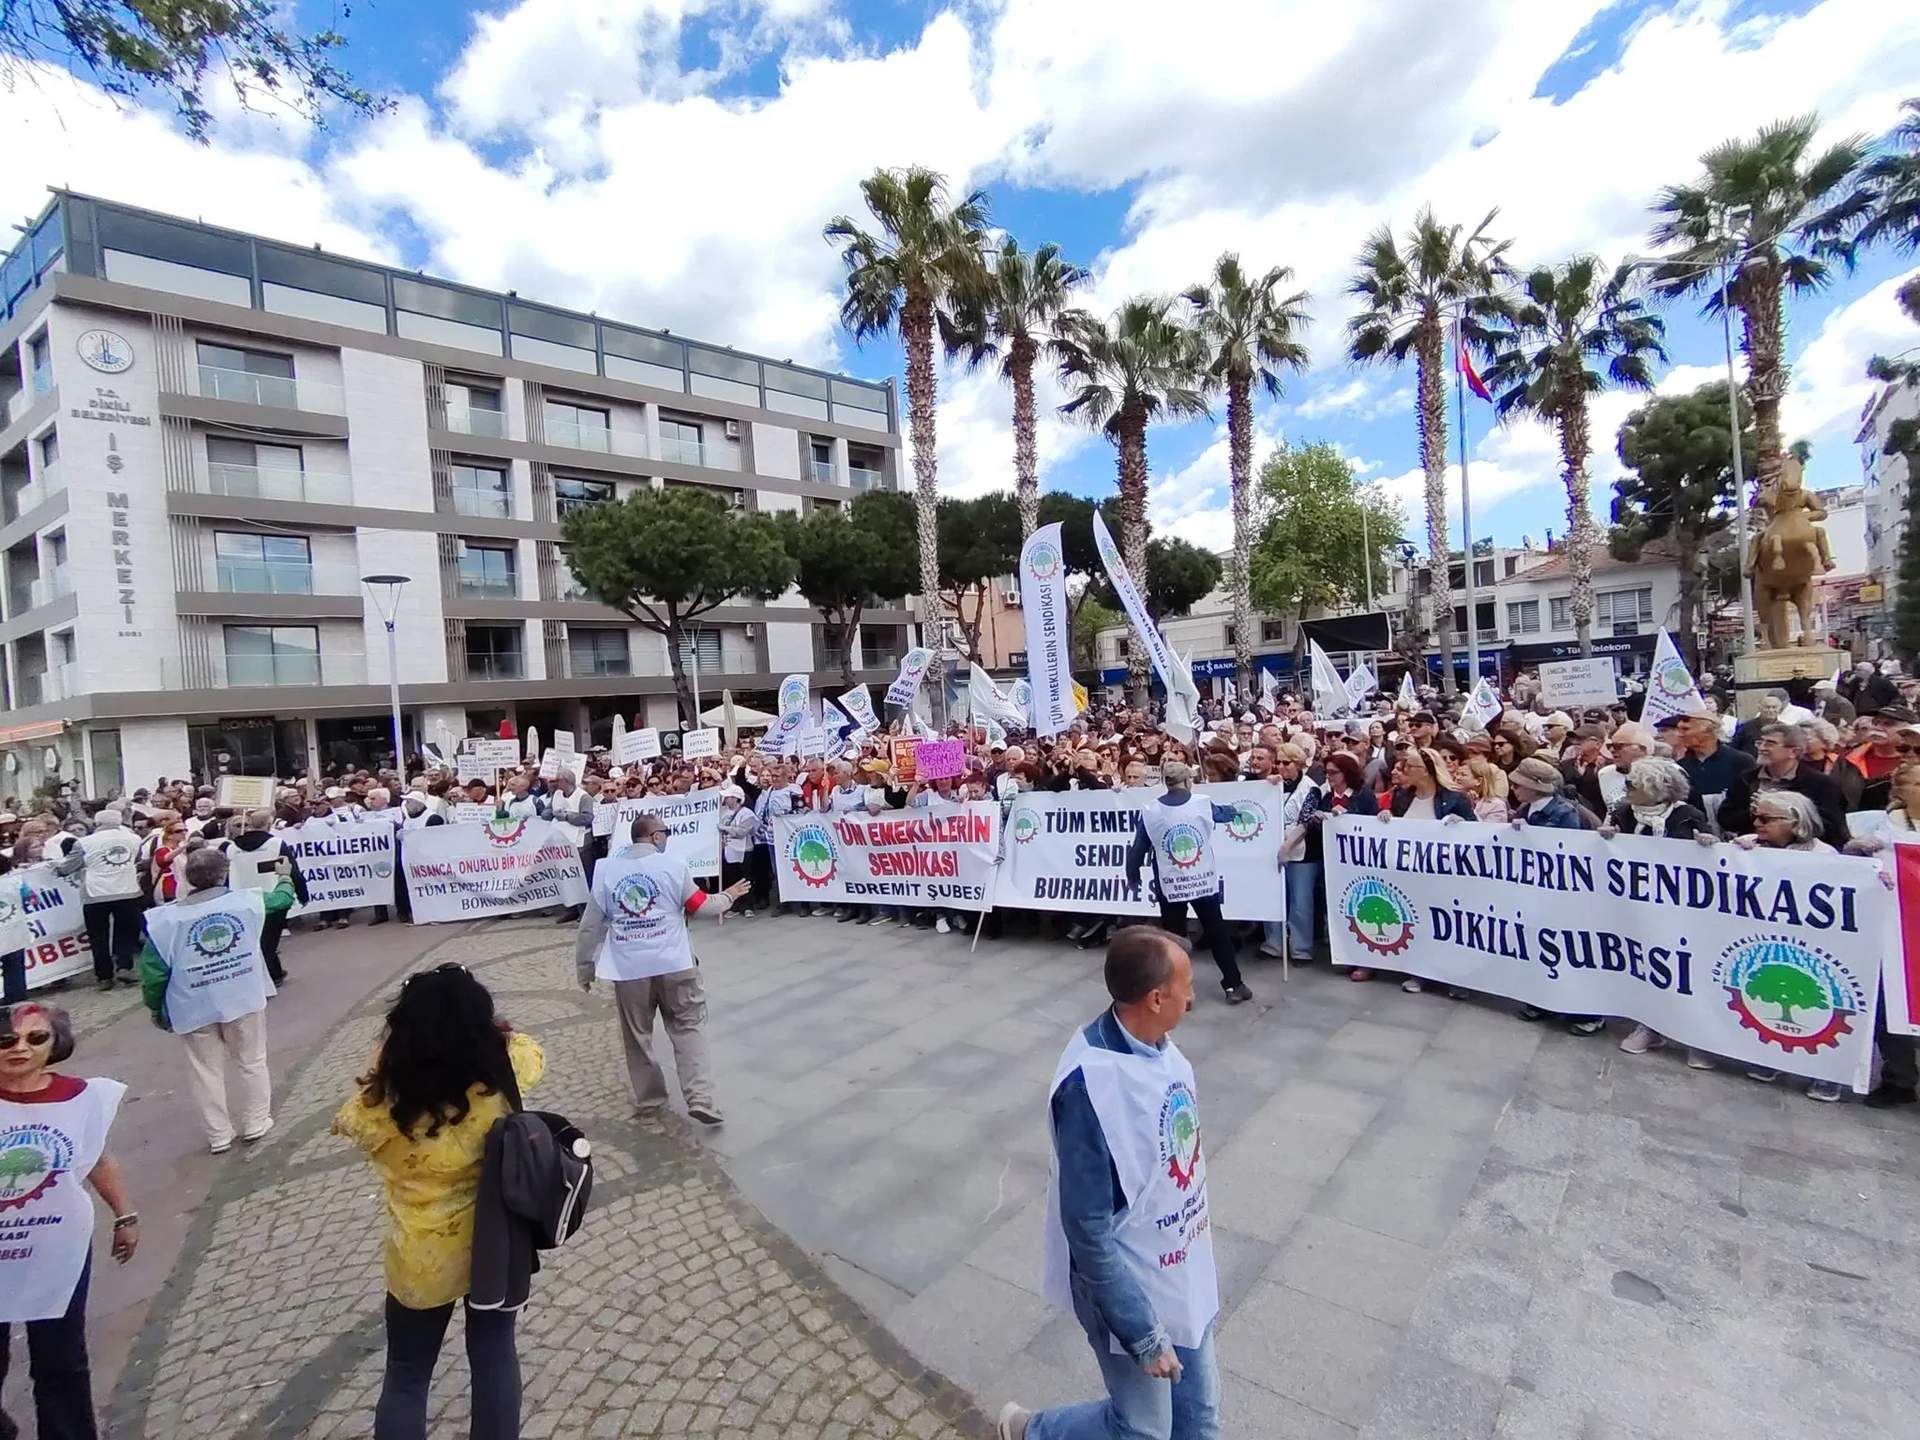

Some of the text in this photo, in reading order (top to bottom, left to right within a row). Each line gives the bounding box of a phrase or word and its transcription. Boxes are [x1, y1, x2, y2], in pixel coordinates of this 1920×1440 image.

[71, 408, 152, 426] BELEDİYESİ
[88, 399, 131, 413] DİKİLİ
[106, 492, 136, 625] MERKEZİ
[833, 817, 867, 847] TÜM
[867, 808, 990, 848] EMEKLİLERİN
[1045, 808, 1085, 834] TÜM
[333, 864, 373, 882] (2017)
[459, 858, 499, 875] ONURLU
[501, 852, 516, 870] BİR
[868, 845, 960, 878] SENDİKASI
[414, 883, 447, 899] TÜM
[845, 879, 987, 902] EDREMİT ŞUBESİ
[1335, 826, 1859, 933] TÜM EMEKLİLERİN SENDİKASI
[328, 888, 365, 901] ŞUBESİ
[518, 882, 560, 905] ŞUBESİ
[1429, 898, 1693, 996] DİKİLİ ŞUBESİ
[1774, 1022, 1803, 1035] 2017
[1156, 1210, 1179, 1231] TÜM
